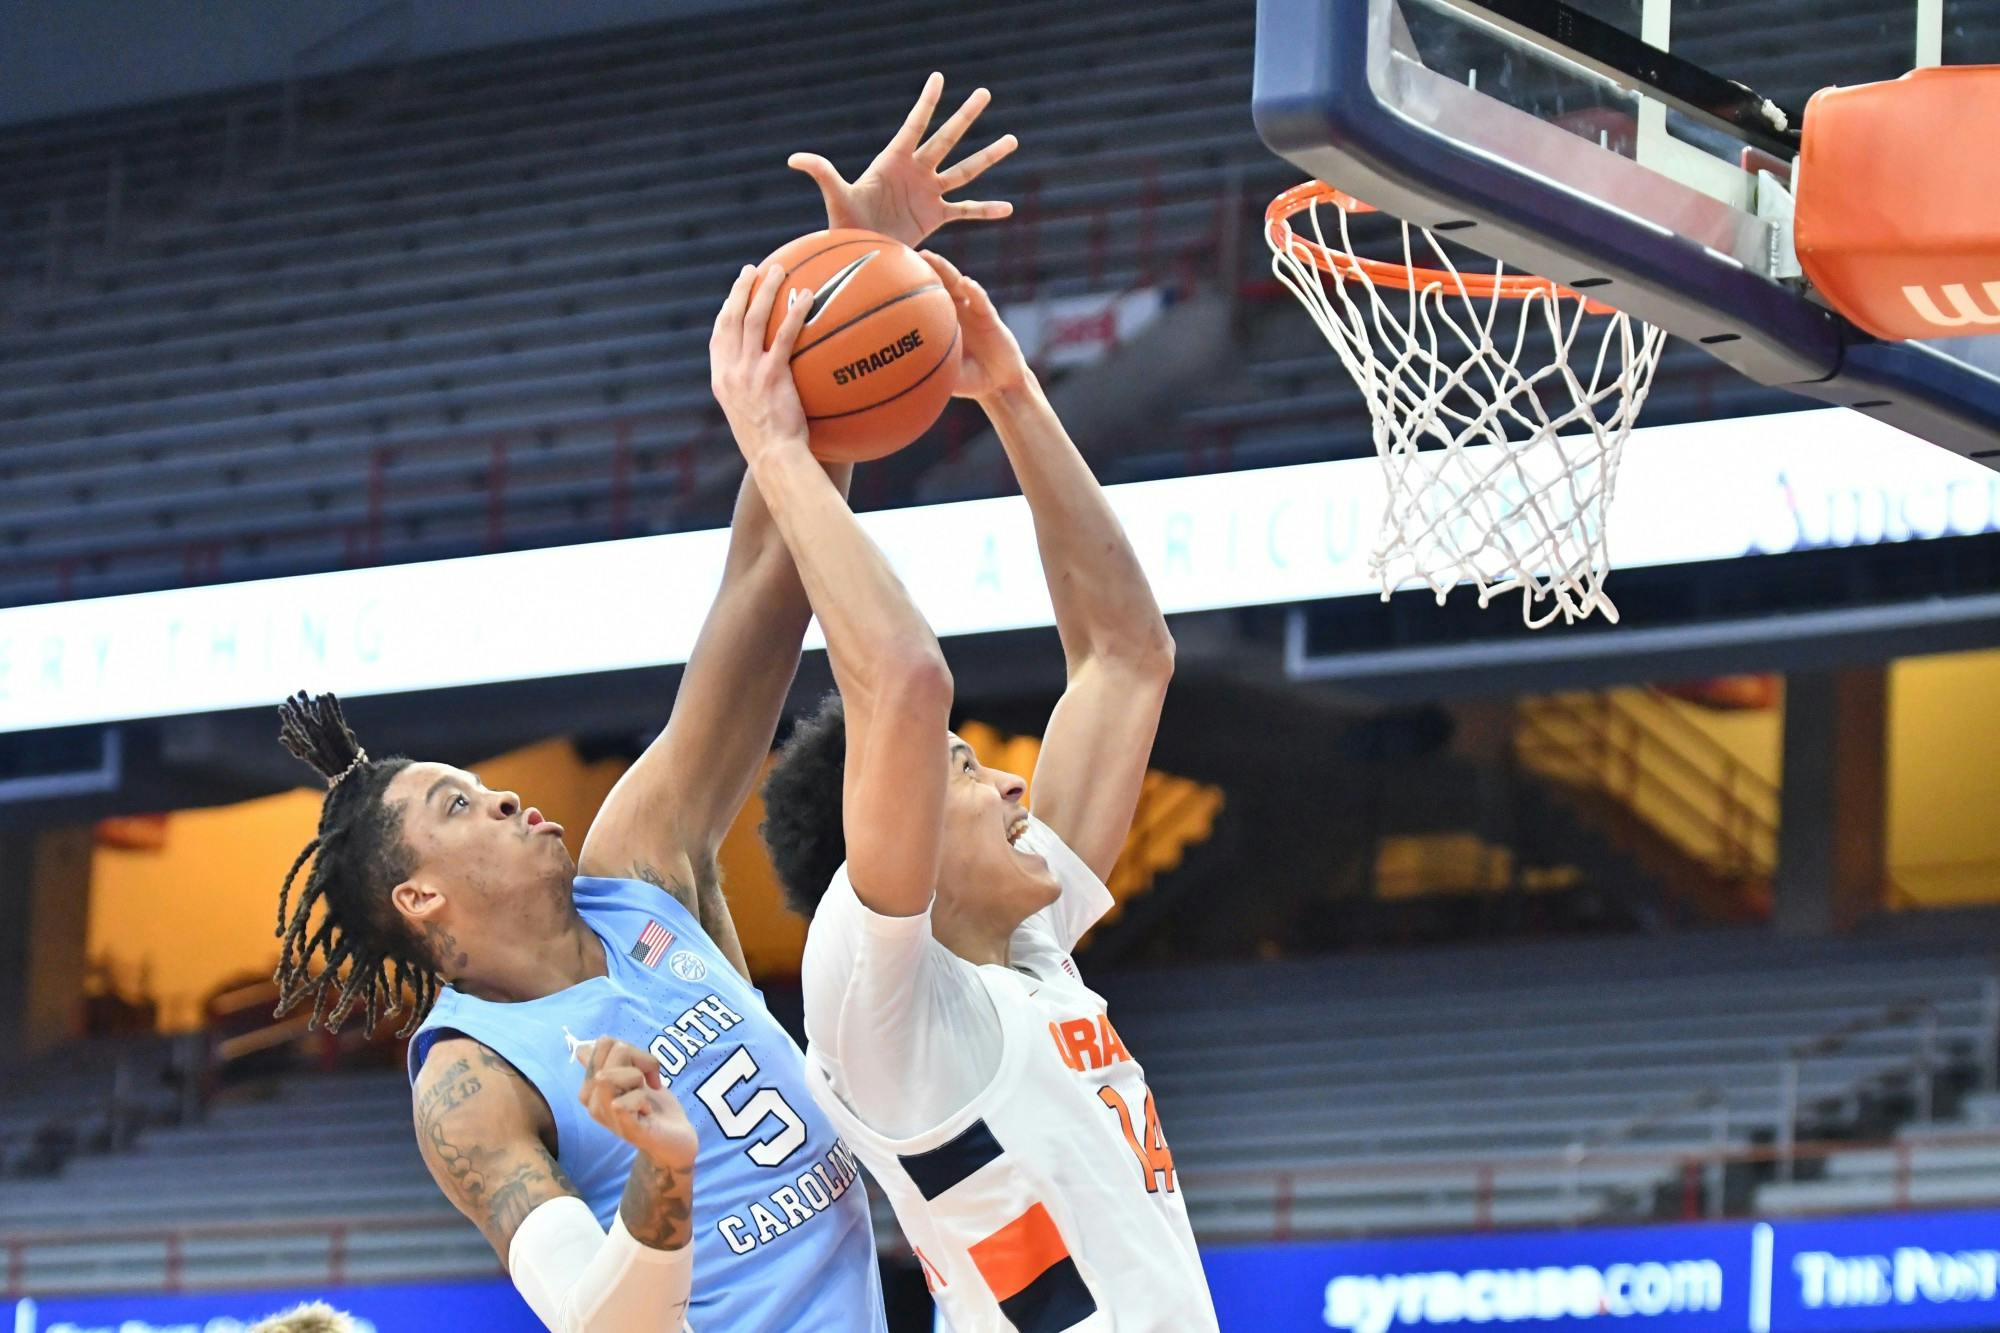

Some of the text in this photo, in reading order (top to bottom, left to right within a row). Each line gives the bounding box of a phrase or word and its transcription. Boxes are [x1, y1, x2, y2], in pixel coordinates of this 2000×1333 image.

[833, 329, 924, 385] SYRACUSE
[693, 1043, 807, 1167] 5
[1097, 1084, 1175, 1193] 14
[1323, 1258, 1723, 1333] syracuse.com
